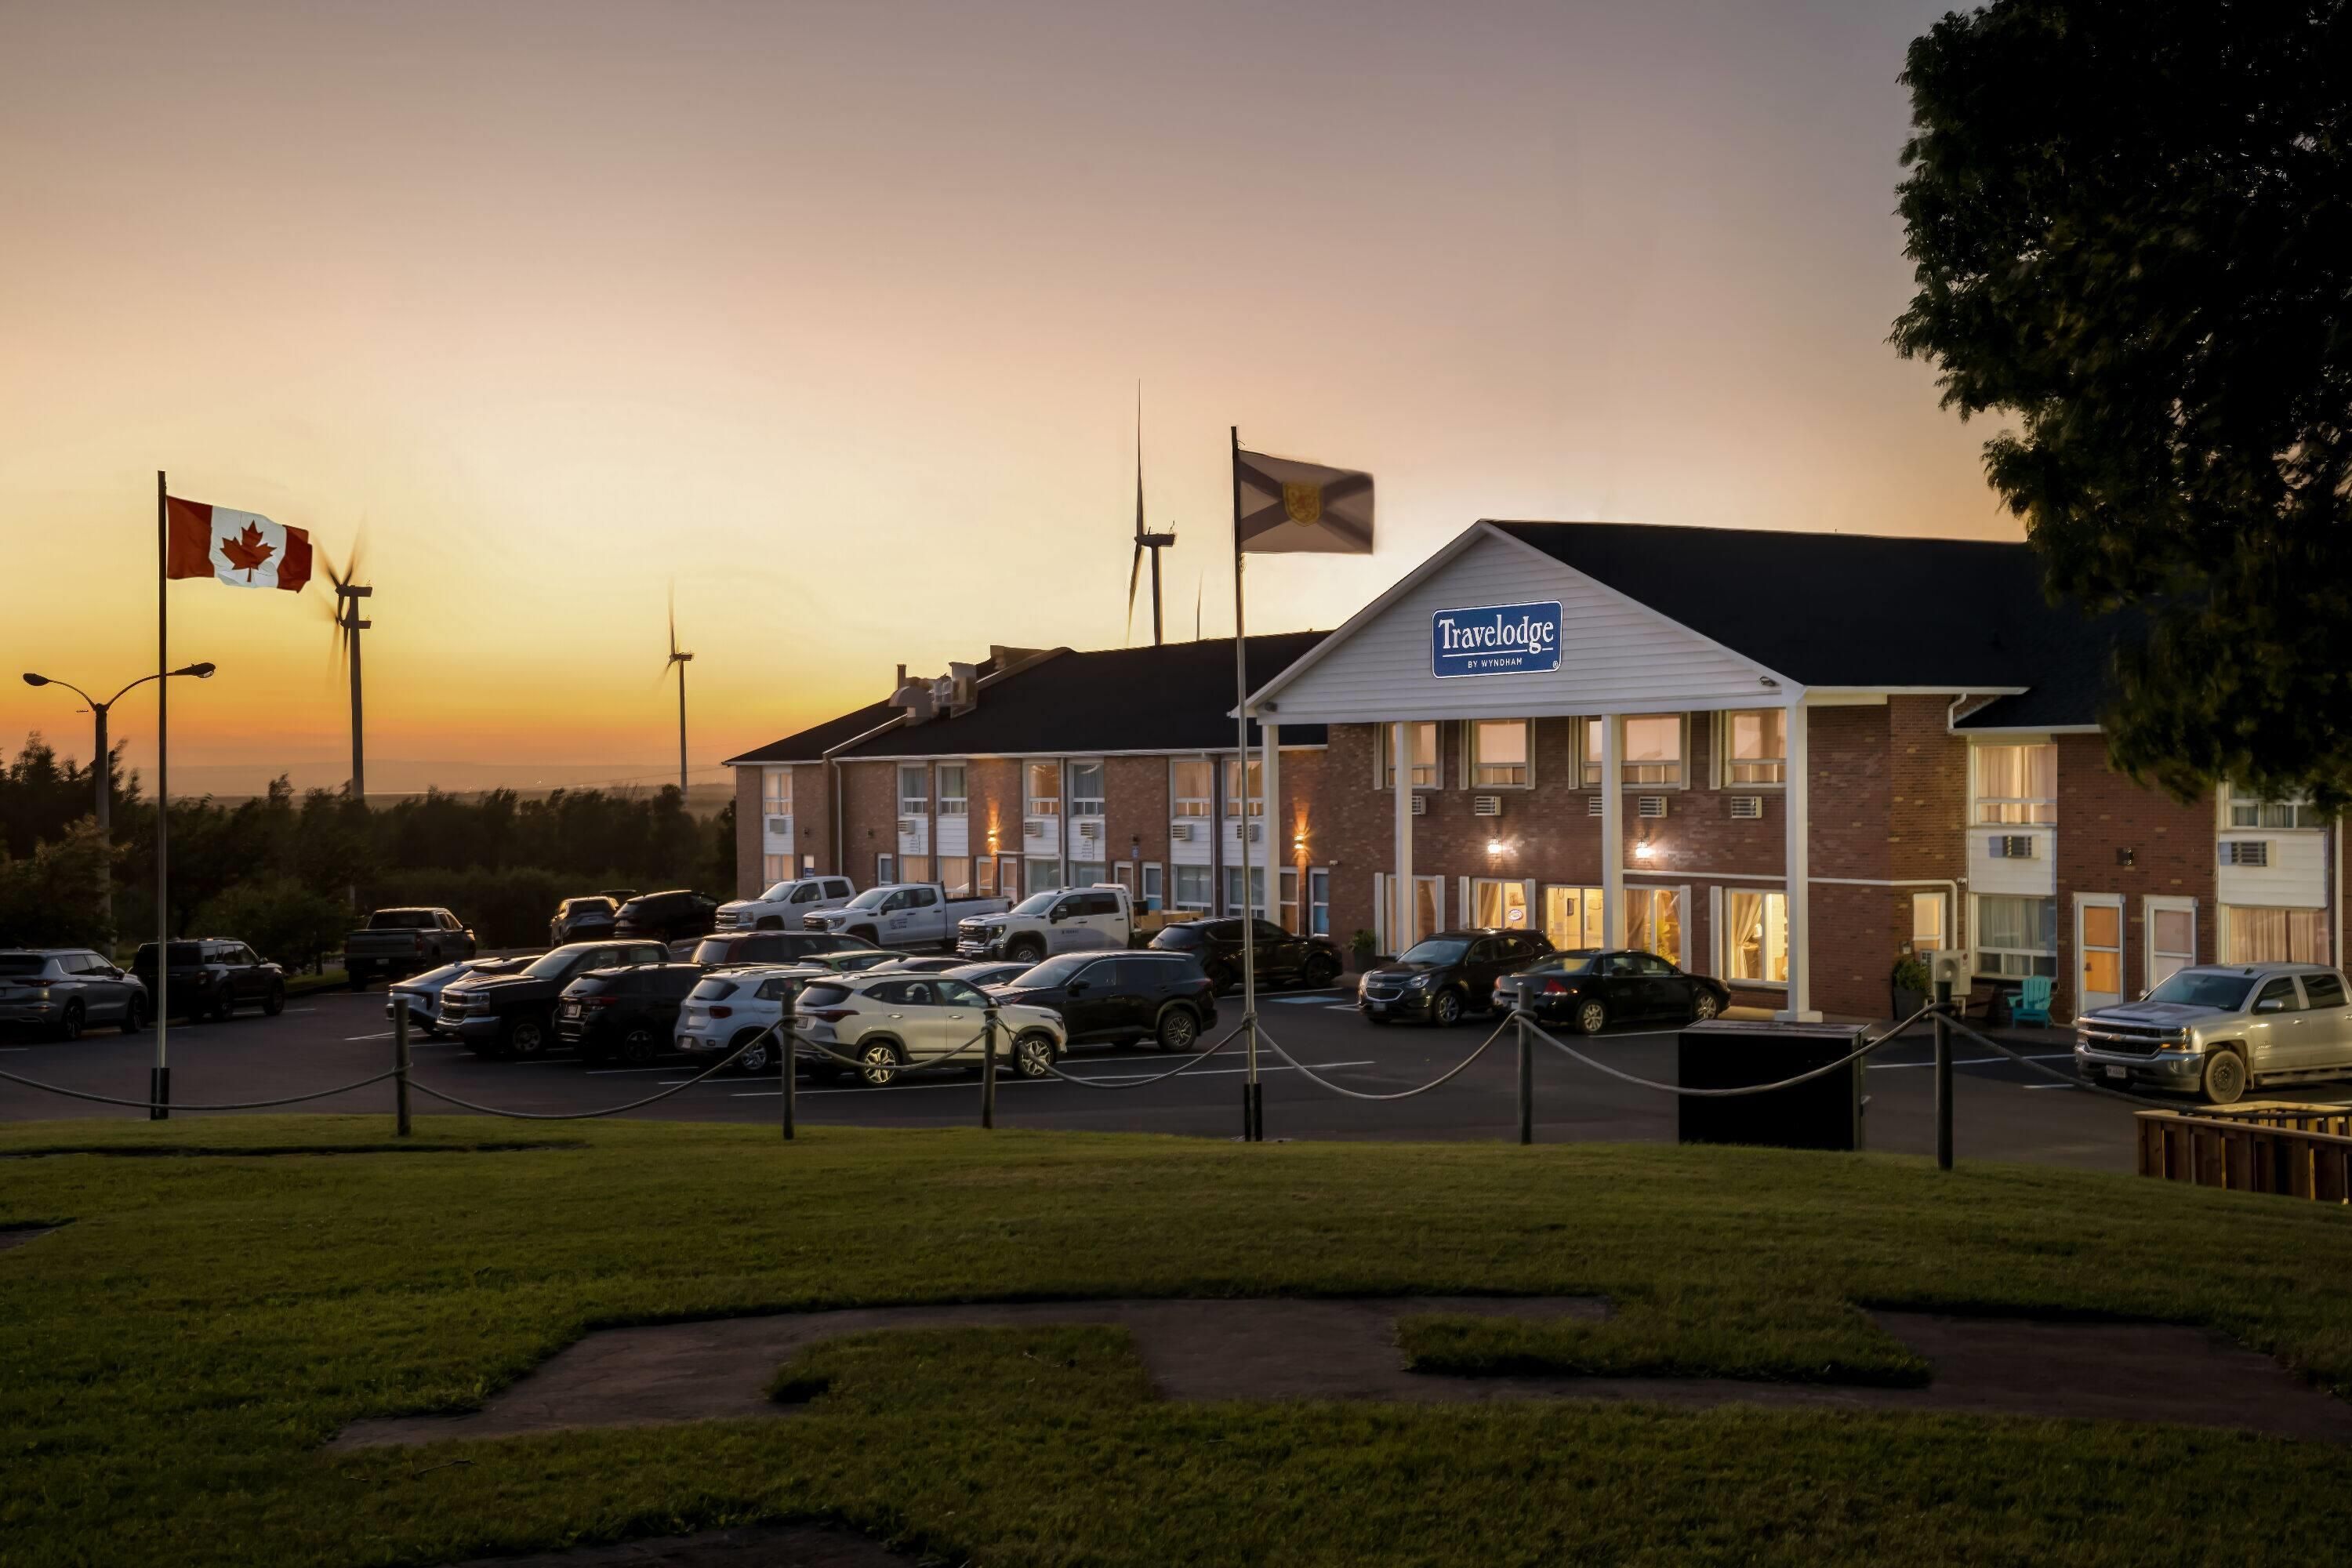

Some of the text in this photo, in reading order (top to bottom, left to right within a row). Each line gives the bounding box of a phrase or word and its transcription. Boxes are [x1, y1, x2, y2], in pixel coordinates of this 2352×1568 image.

[1439, 614, 1554, 655] Travelodge
[1468, 657, 1523, 669] BY WYNDHAM
